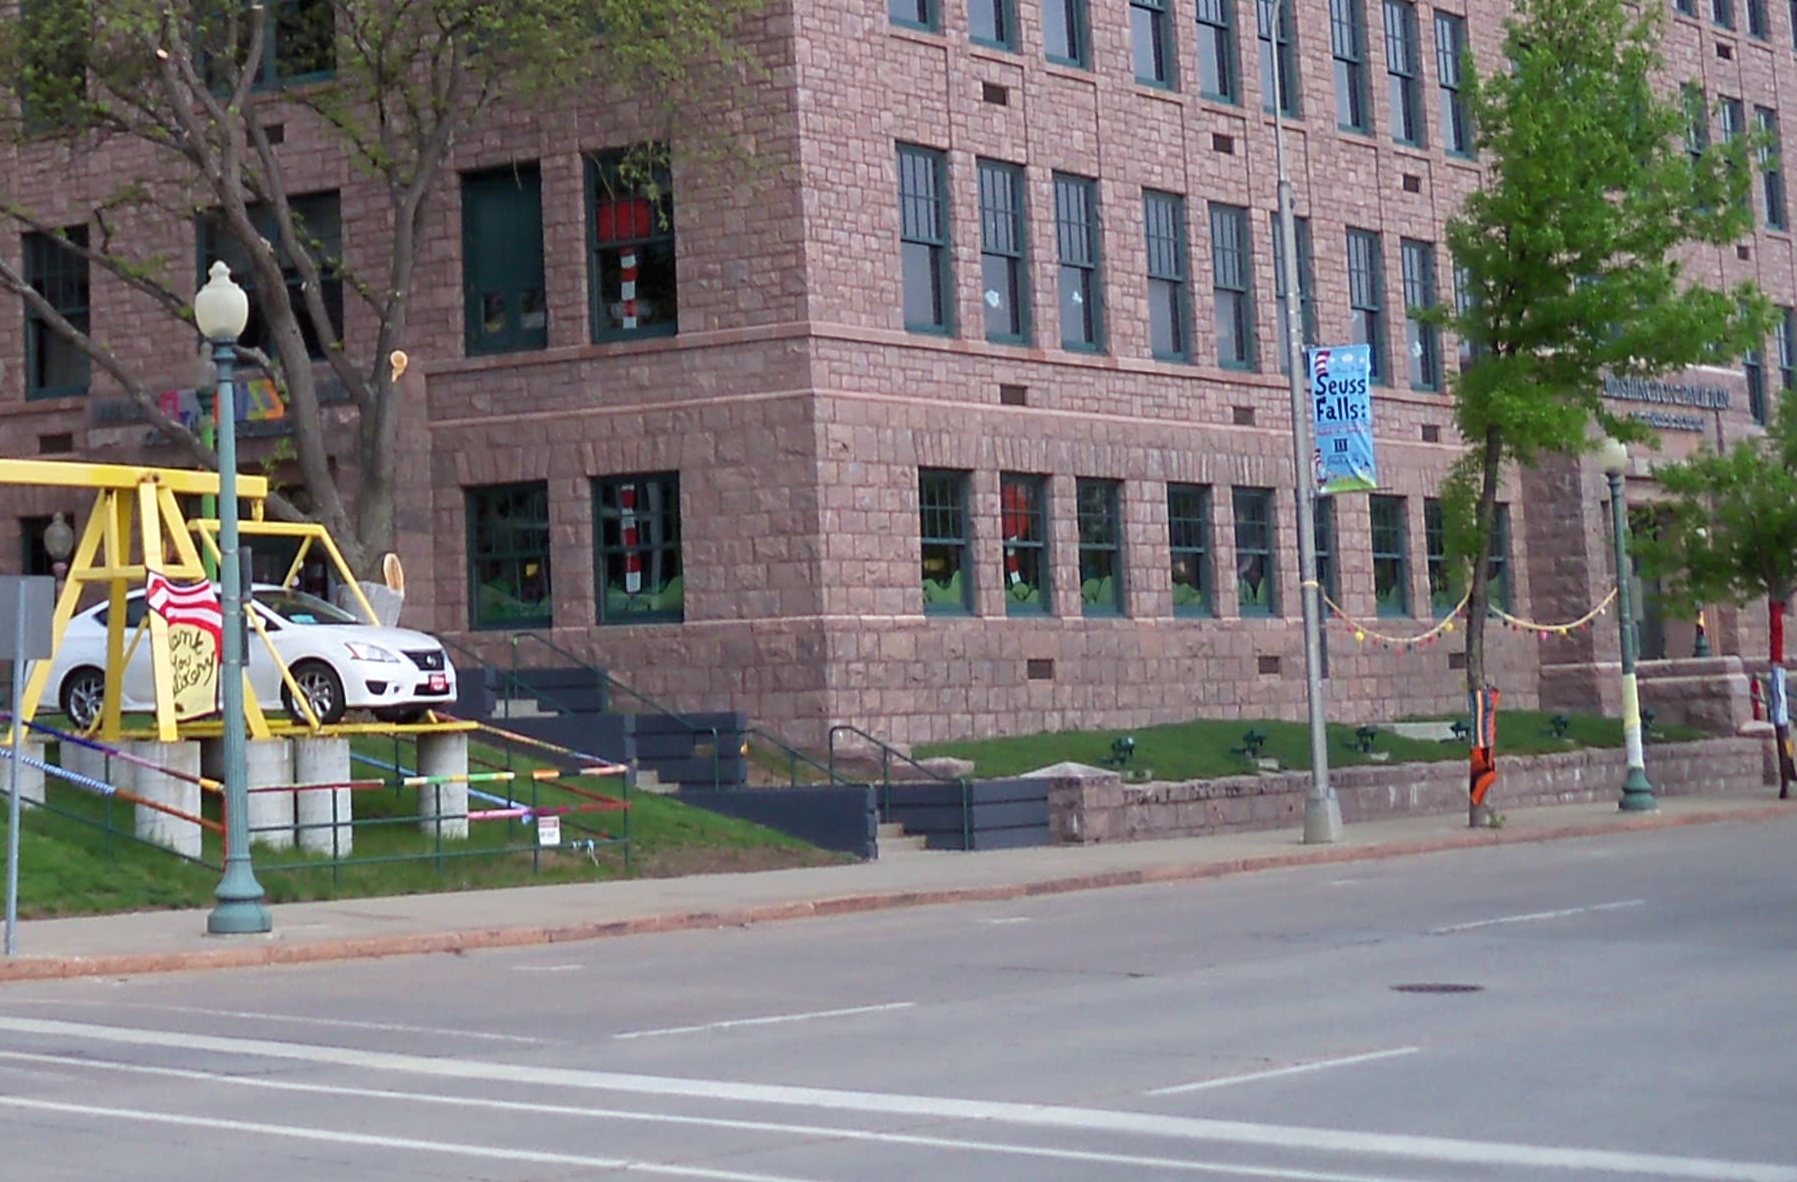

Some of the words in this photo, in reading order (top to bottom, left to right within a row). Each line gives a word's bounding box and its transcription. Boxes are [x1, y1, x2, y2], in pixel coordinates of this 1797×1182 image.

[1315, 372, 1366, 395] Seuss
[1316, 396, 1366, 421] Falls:
[170, 631, 204, 656] ank
